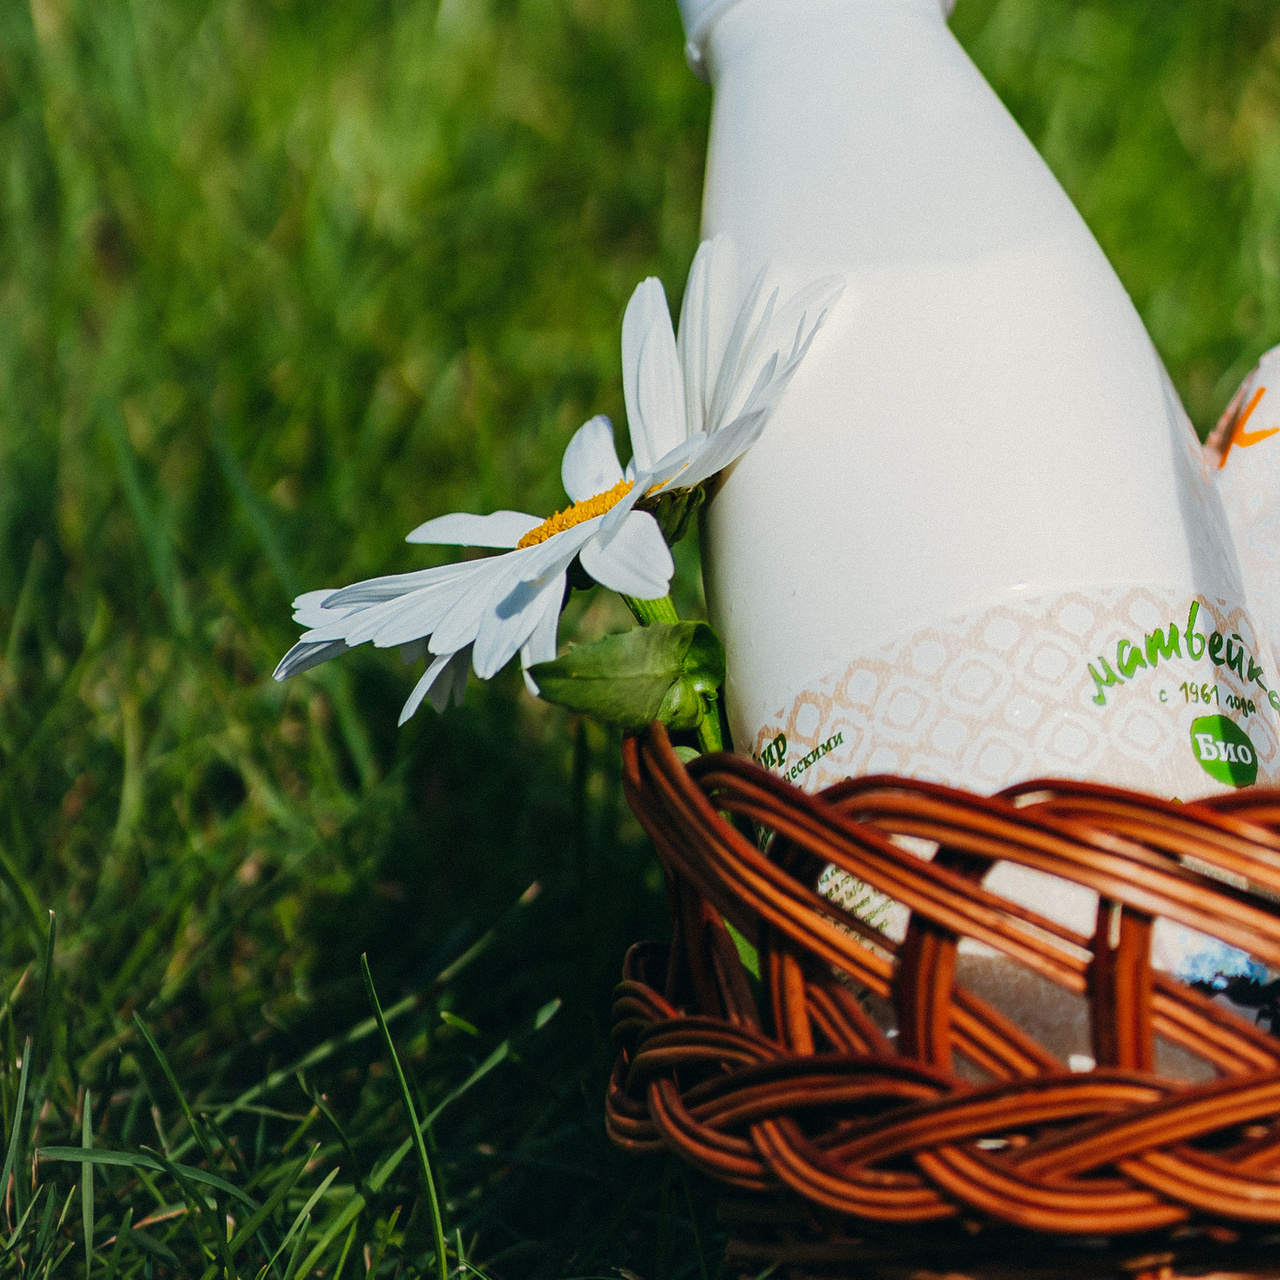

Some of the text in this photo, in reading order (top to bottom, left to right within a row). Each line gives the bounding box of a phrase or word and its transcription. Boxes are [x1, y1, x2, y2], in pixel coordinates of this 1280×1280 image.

[1179, 681, 1220, 706] 1961
[1226, 693, 1257, 719] года
[1194, 733, 1253, 766] Био
